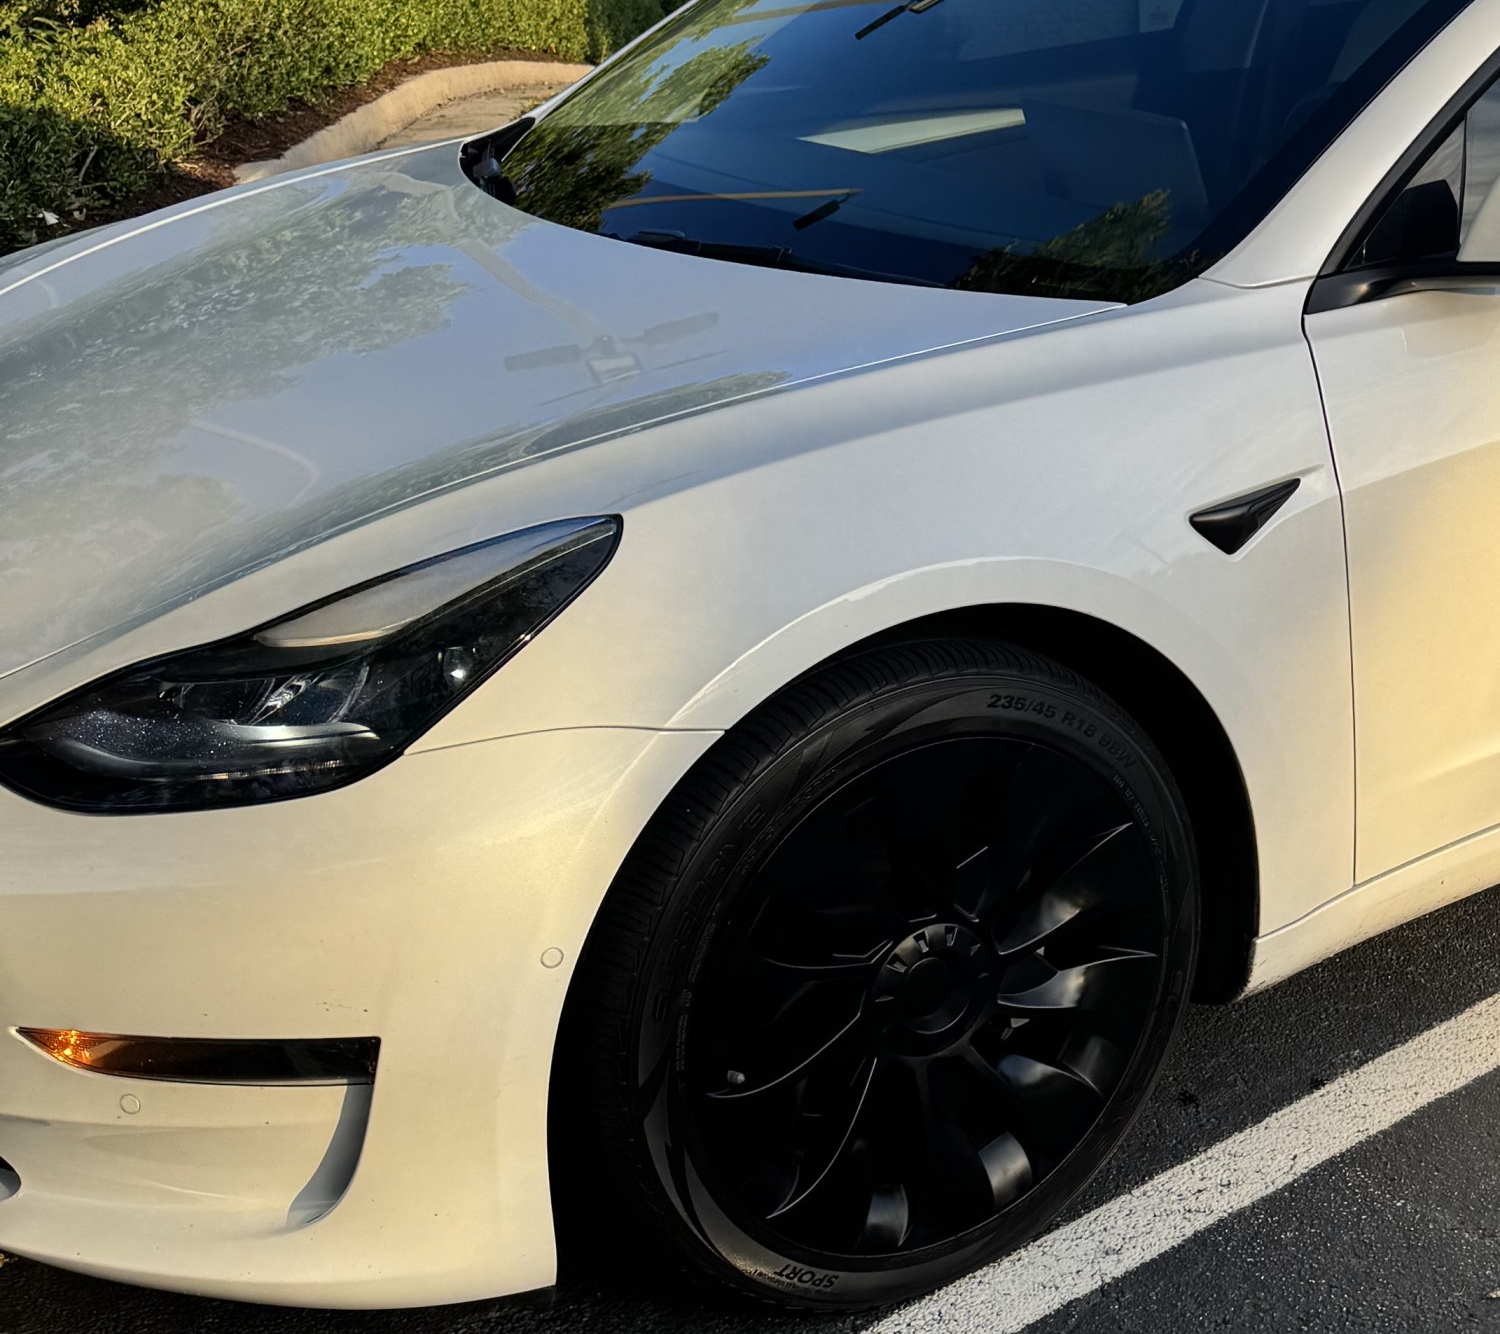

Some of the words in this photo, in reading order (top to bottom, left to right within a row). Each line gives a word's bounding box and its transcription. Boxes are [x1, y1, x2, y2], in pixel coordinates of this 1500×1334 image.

[986, 694, 1058, 718] 235/45
[1061, 712, 1098, 737] R18
[774, 1264, 840, 1289] SPORT
